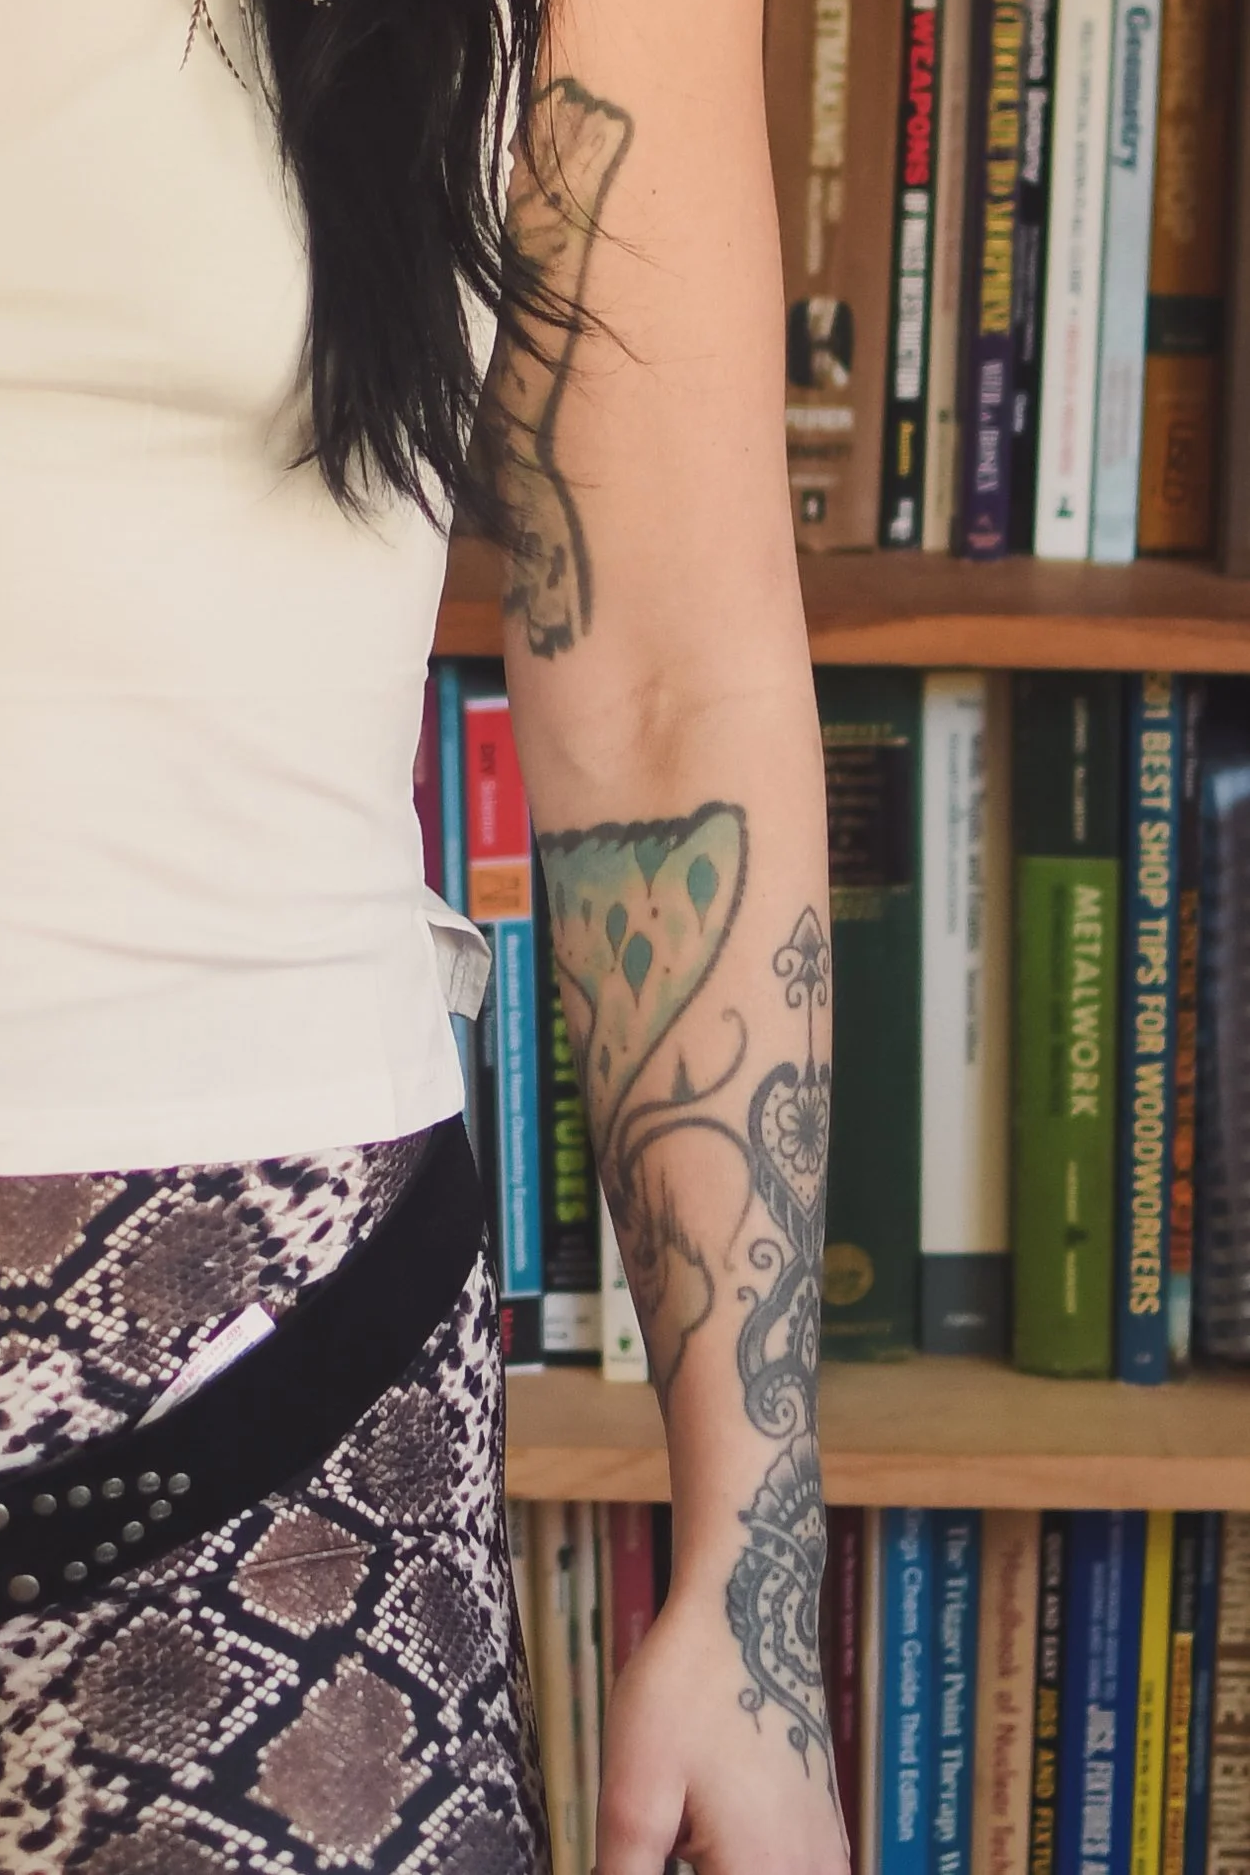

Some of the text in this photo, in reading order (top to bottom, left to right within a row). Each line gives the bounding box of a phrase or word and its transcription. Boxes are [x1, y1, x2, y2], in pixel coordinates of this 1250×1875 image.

[903, 10, 939, 187] WEAPONS
[988, 7, 1026, 153] CHOCOLATE
[1020, 87, 1050, 186] Botany
[1110, 6, 1152, 171] Geometry
[987, 159, 1019, 195] TO
[1164, 121, 1200, 243] SHOP
[901, 218, 929, 272] MASS
[980, 201, 1020, 338] MORPHINE
[896, 275, 928, 401] DESTRUCTION
[479, 741, 499, 847] DIY Science
[1066, 884, 1103, 1117] METALWORK
[1127, 672, 1172, 1317] 501 BEST SHOP TIPS FOR WOODWORKERS
[506, 933, 531, 1272] Illustrated Guide to Home Chemistry Experiments
[553, 1096, 590, 1222] TUBES
[901, 1639, 925, 1709] Guide
[933, 1525, 973, 1844] The Trigger Point Therapy
[1031, 1533, 1063, 1875] QUICK AND EASY JIGS AND FIXTU
[899, 1712, 924, 1765] Third
[898, 1768, 923, 1843] Edition
